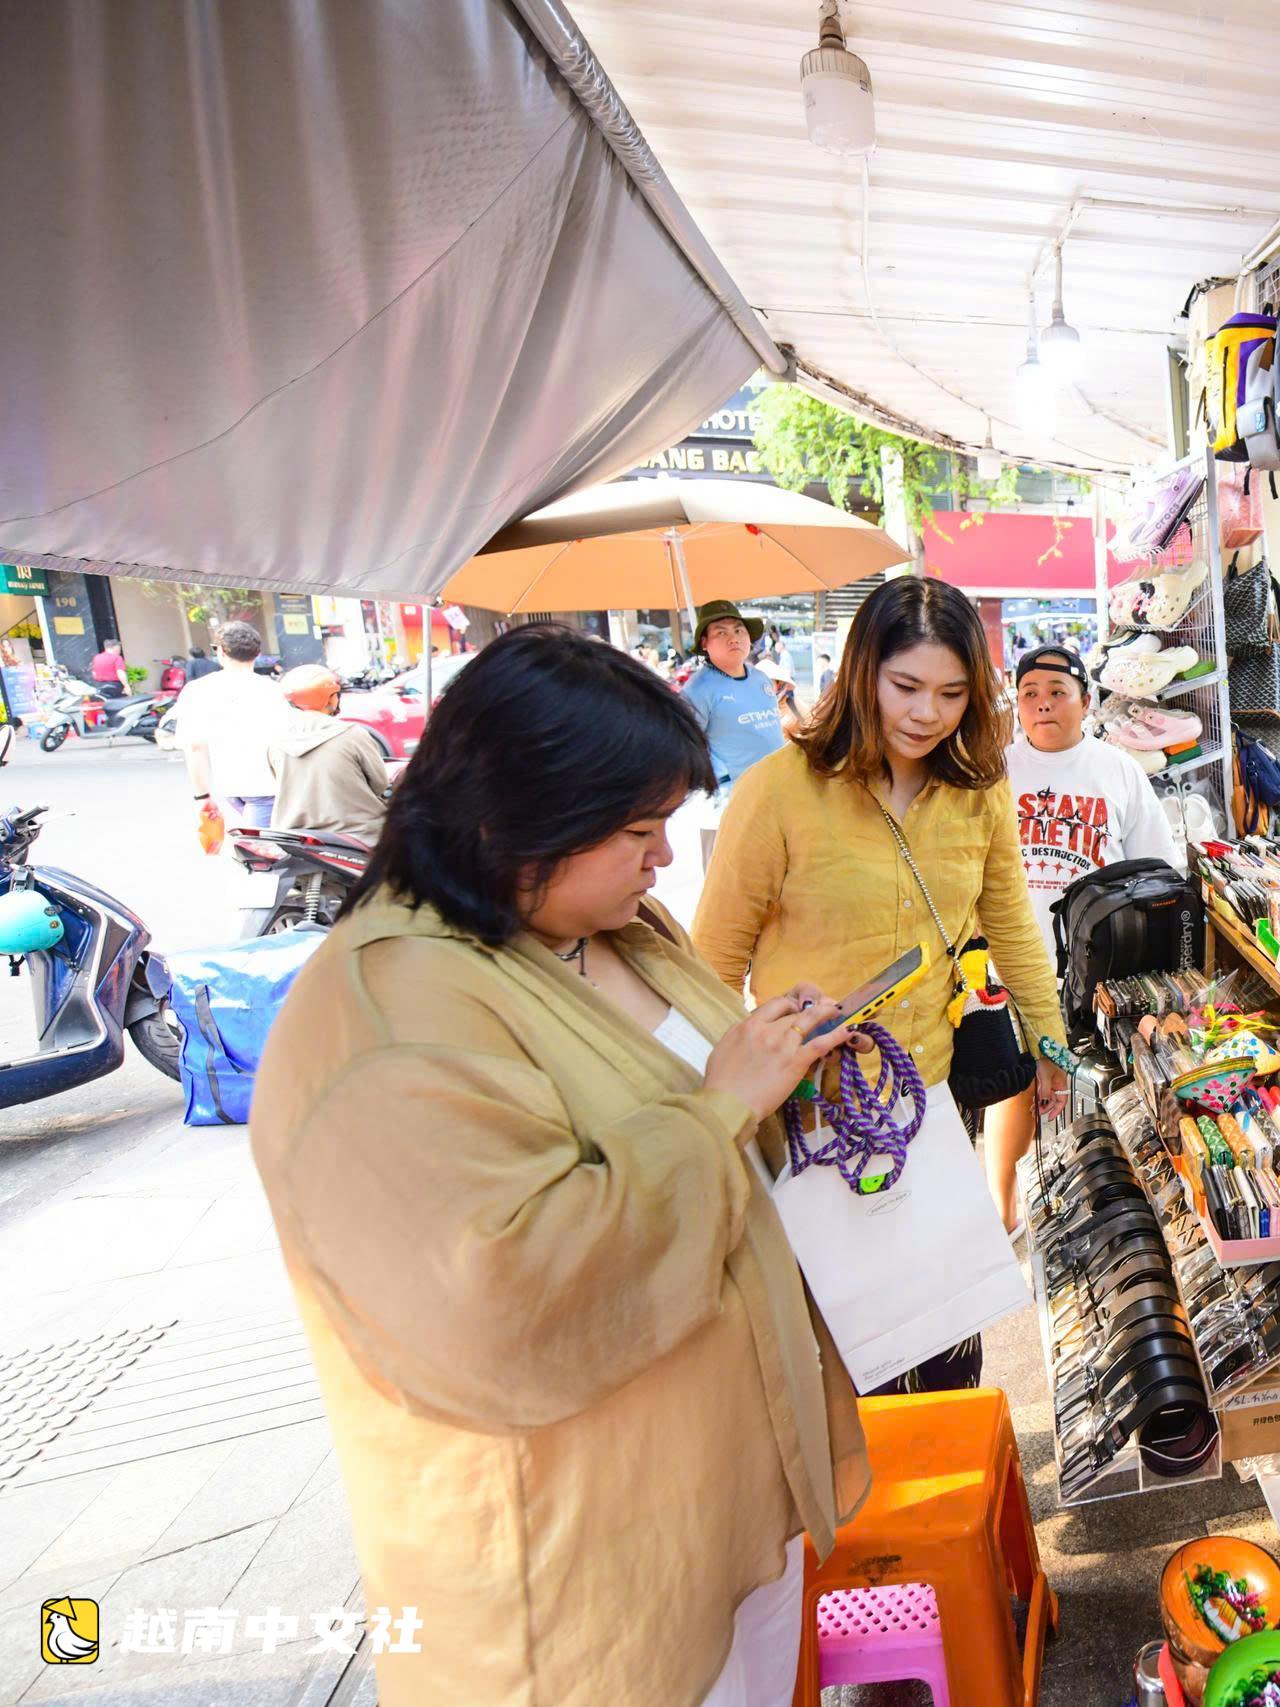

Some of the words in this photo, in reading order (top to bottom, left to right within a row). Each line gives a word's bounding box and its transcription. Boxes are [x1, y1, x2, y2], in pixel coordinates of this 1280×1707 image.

[1155, 502, 1180, 530] crocs
[55, 597, 77, 608] 190
[1032, 847, 1092, 870] DESTRUCTION
